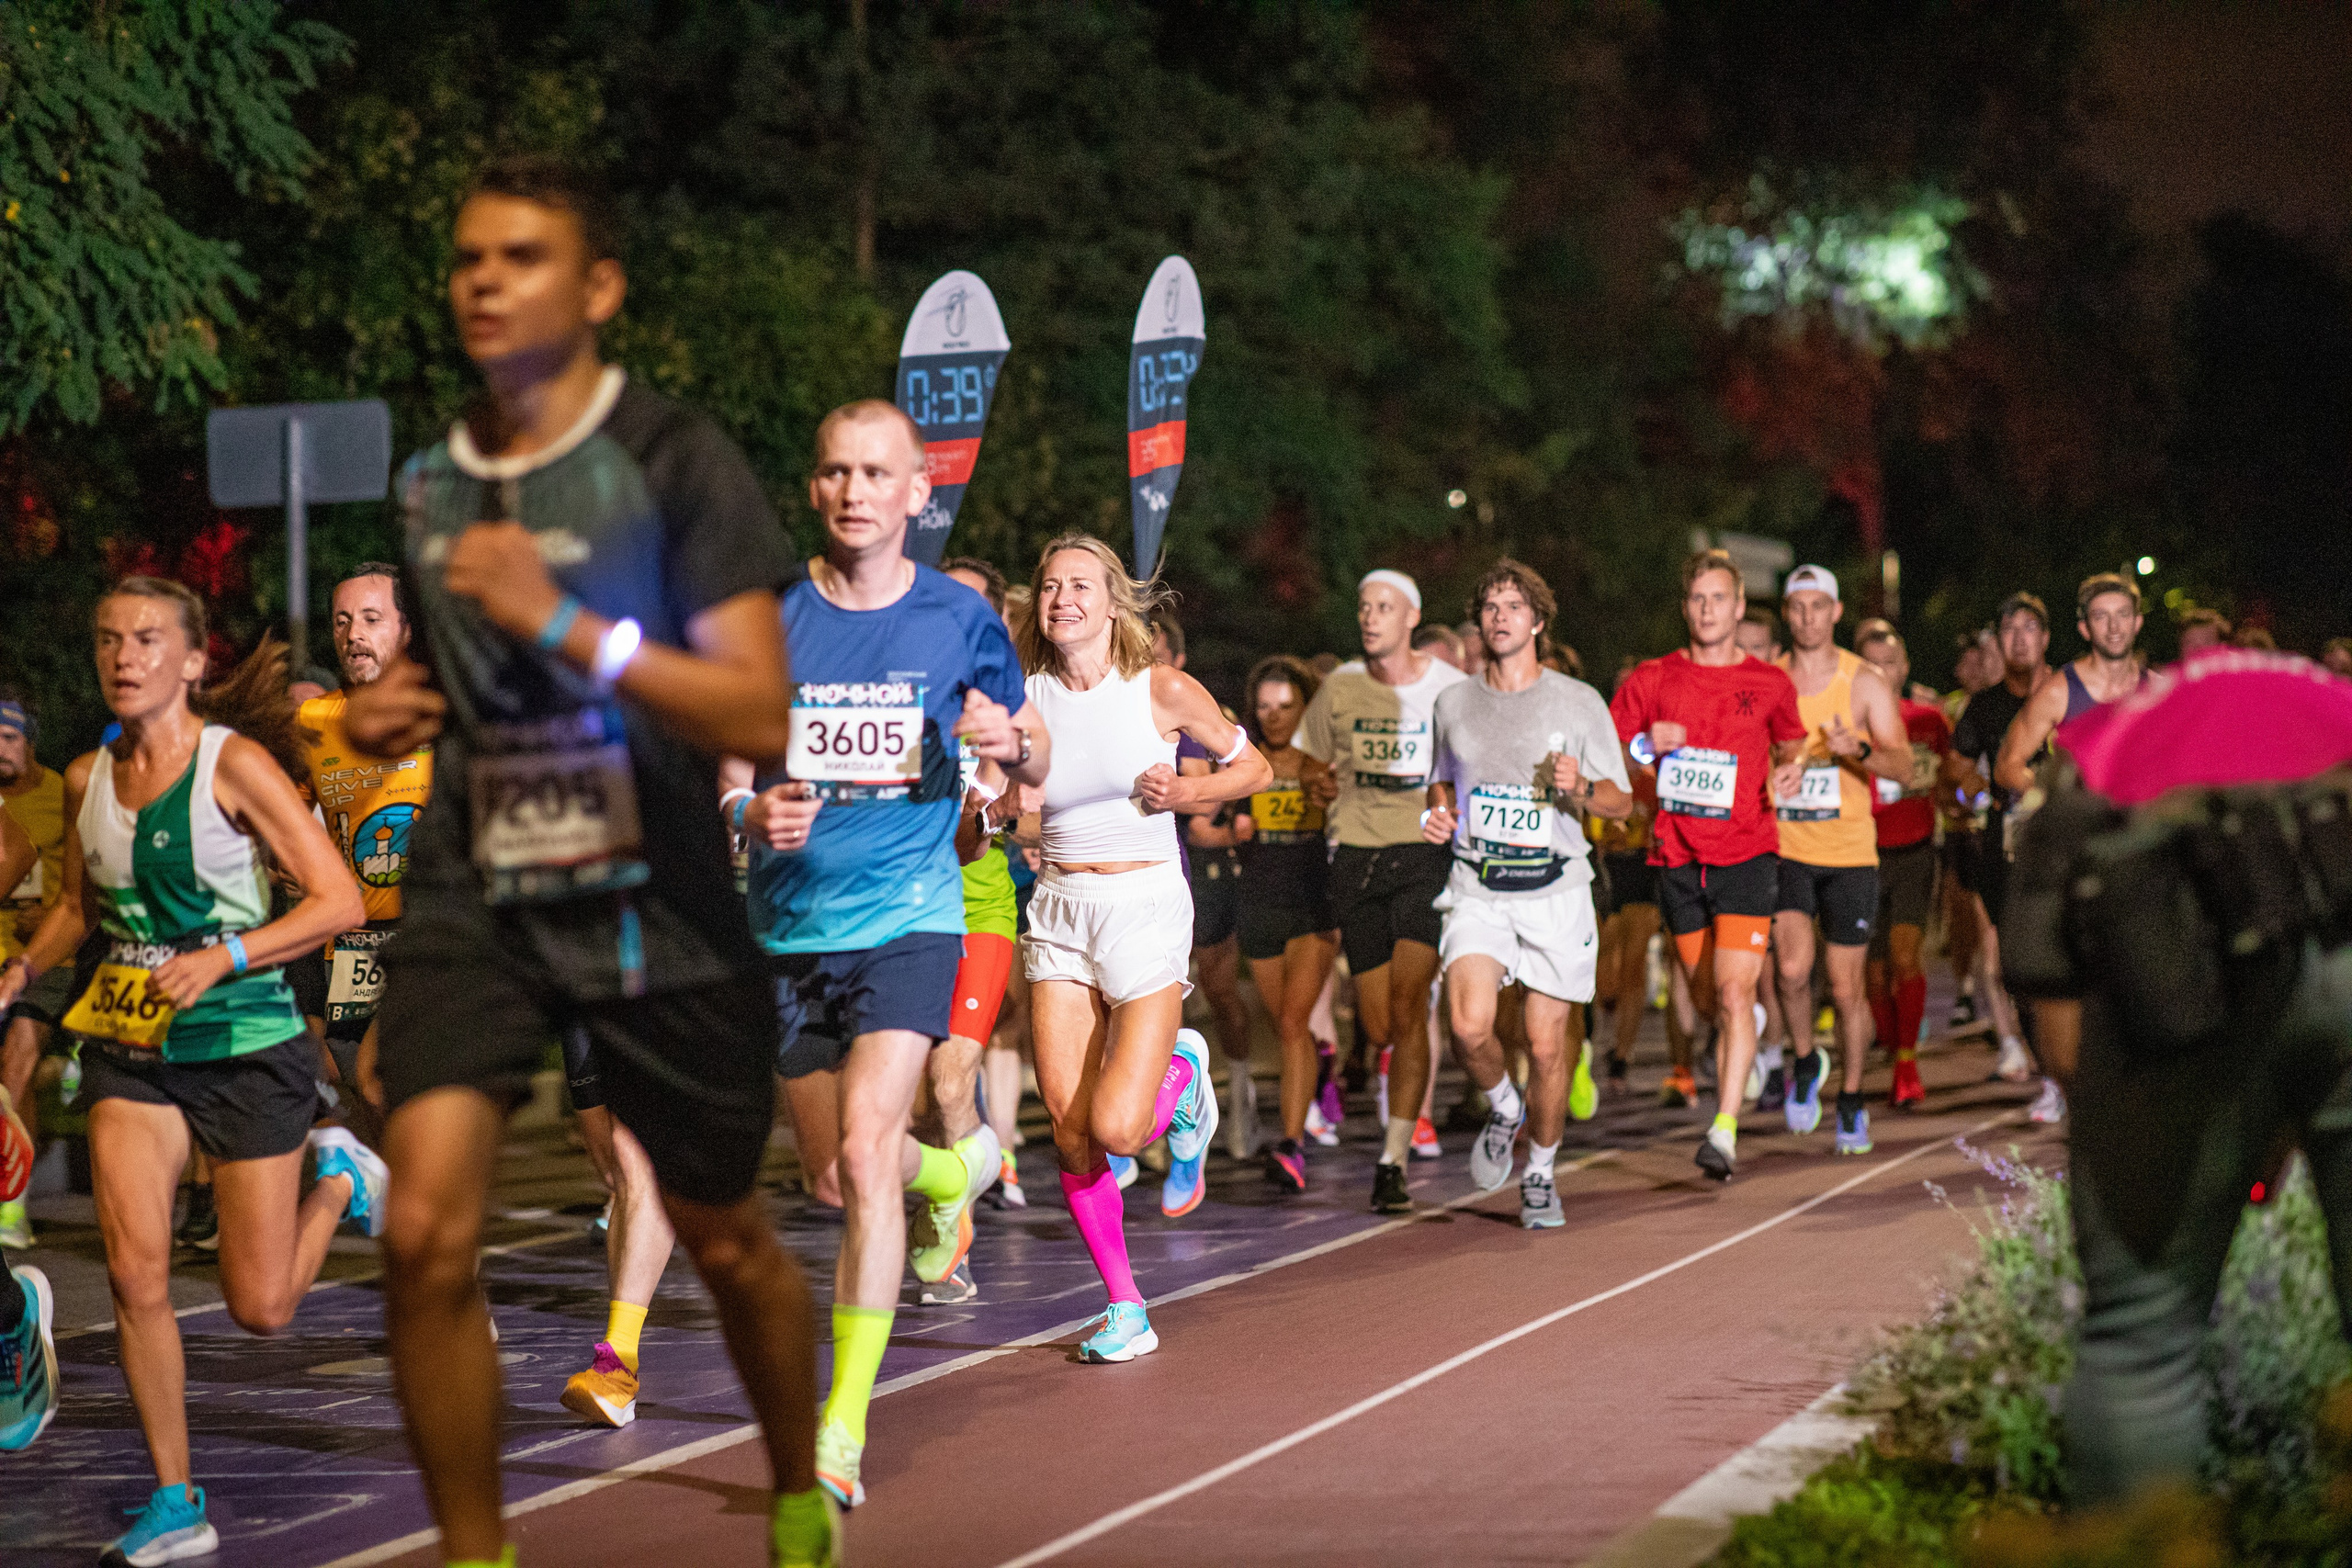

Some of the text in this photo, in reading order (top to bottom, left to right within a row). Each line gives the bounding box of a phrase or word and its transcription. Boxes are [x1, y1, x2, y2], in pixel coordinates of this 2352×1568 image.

[807, 721, 904, 756] 3605
[1363, 740, 1417, 761] 3369
[321, 760, 417, 783] NEVER
[824, 761, 885, 772] НИКОЛАЙ
[322, 777, 382, 796] GIVE
[1670, 767, 1724, 791] 3986
[322, 795, 355, 808] UP
[1482, 805, 1541, 830] 7120
